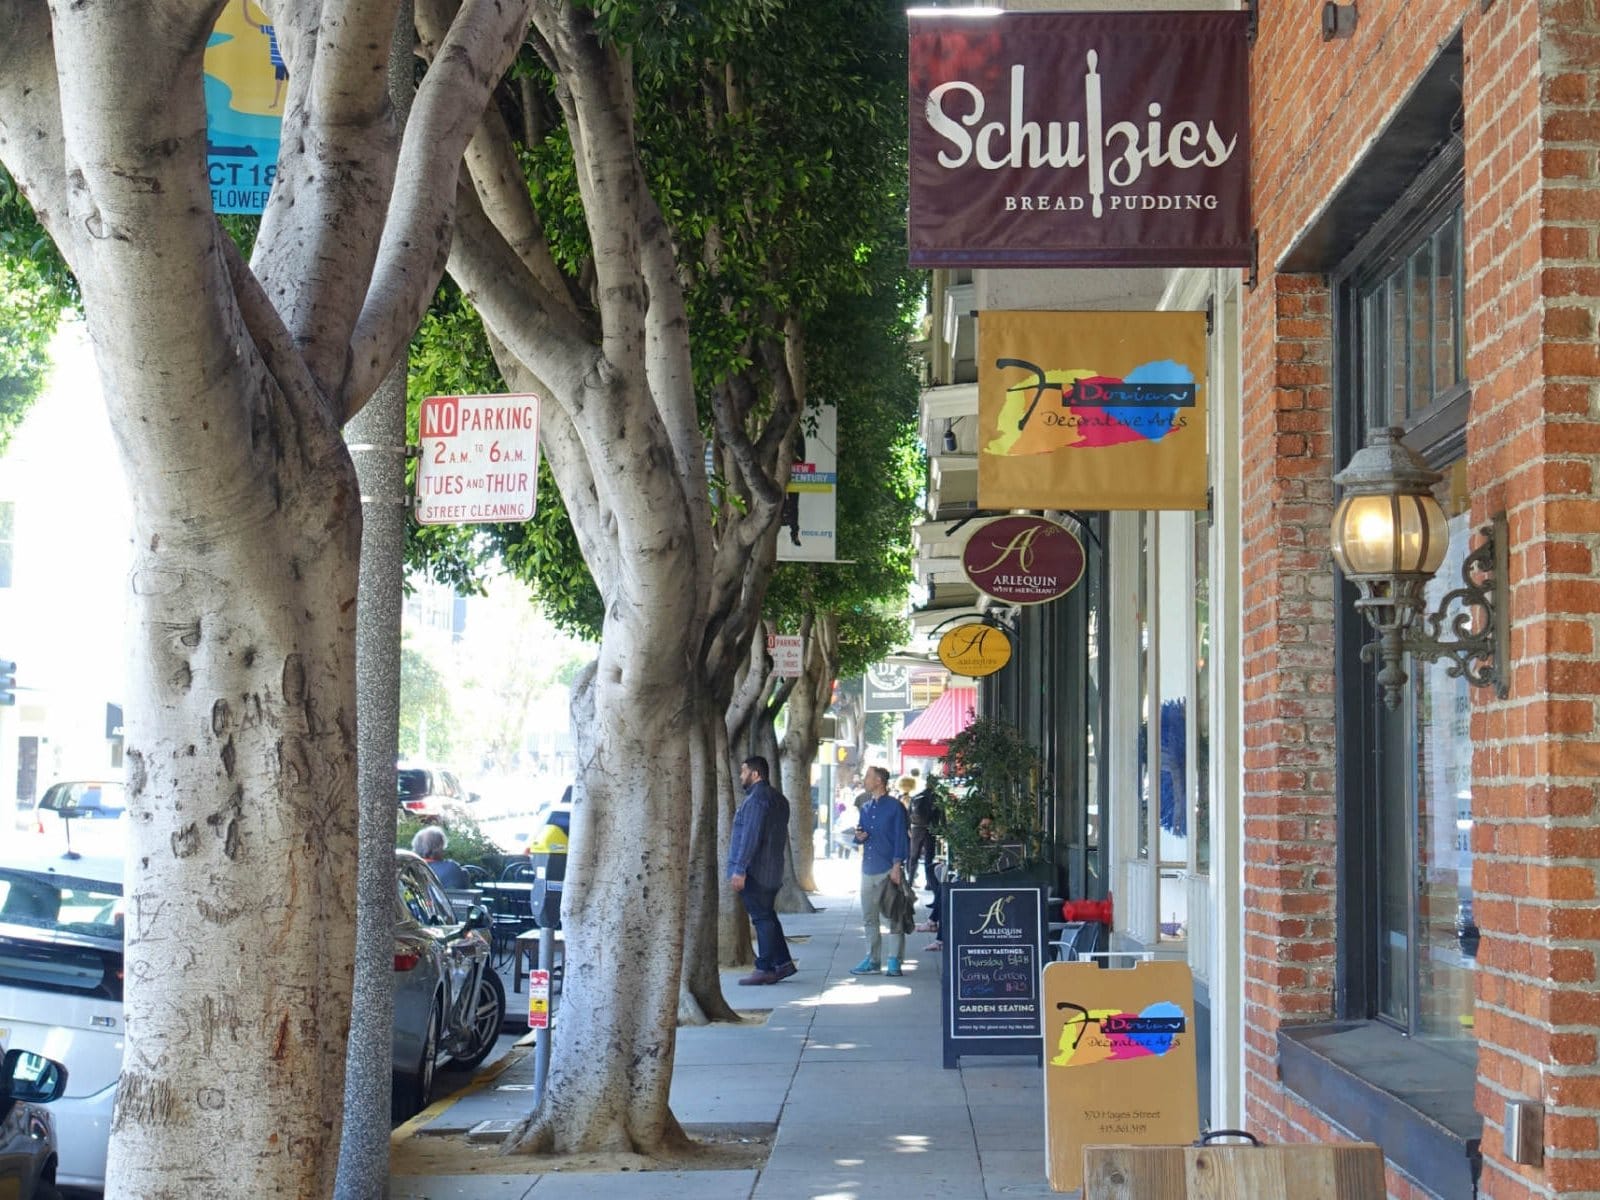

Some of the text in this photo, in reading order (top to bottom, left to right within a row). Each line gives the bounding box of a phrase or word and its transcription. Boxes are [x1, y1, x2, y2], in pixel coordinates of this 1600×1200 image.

[208, 162, 243, 186] CT
[1005, 195, 1219, 211] BREAD PUDDING
[425, 403, 532, 434] NO PARKING
[1041, 410, 1188, 428] Decorative Arts
[434, 440, 527, 464] 2 A.M. TO 6 A.M.
[425, 473, 528, 495] TUES AND THUR
[427, 503, 525, 518] STREET CLEANING
[968, 525, 1042, 573] A
[993, 575, 1057, 588] ARLEQUIN
[983, 928, 1022, 936] ARLEQUIN
[961, 956, 1003, 969] Thursday
[998, 1004, 1034, 1012] SEATING
[1132, 1111, 1160, 1119] Street
